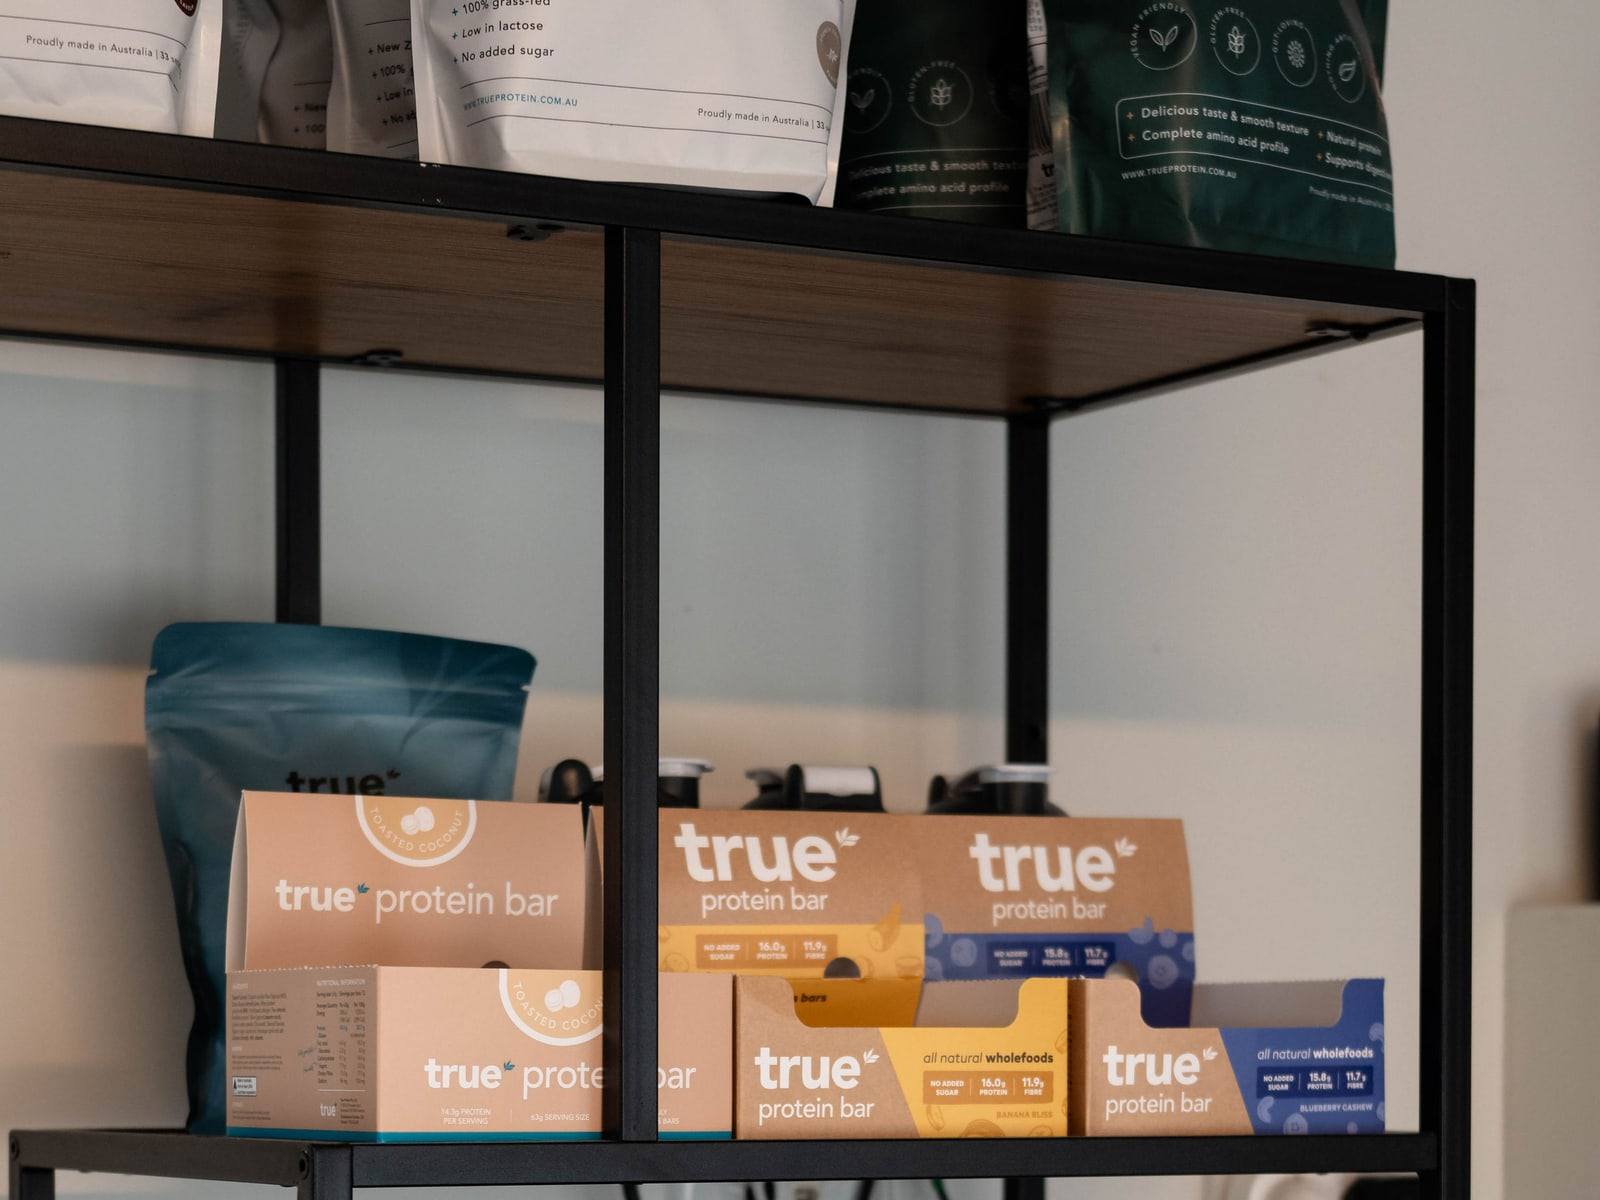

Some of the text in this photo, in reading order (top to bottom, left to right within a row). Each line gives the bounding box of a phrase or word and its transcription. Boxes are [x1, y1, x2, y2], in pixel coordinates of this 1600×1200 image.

[463, 0, 489, 15] 100%
[462, 21, 544, 39] Low in lactose
[26, 35, 64, 50] Proudly
[68, 41, 95, 51] made
[98, 41, 107, 52] in
[111, 43, 153, 57] Australia
[462, 45, 555, 63] No added sugar
[698, 108, 825, 130] Proudly made in Australia 33
[1141, 106, 1311, 137] Delicious taste & smooth texture
[1142, 127, 1291, 156] Complete amino acid profile
[370, 807, 465, 854] TOASTED COCONUT
[674, 822, 838, 882] true
[969, 832, 1116, 892] true
[275, 879, 559, 924] true protein bar
[702, 886, 829, 919] protein bar
[993, 895, 1107, 927] protein bar
[513, 980, 604, 1031] TOASTED COCON
[801, 993, 827, 1003] bars
[922, 1052, 1054, 1064] all natural wholefoods
[1257, 1047, 1374, 1061] all natural wholefoods
[755, 1046, 861, 1090] true
[1102, 1045, 1200, 1086] true
[424, 1058, 604, 1101] true prote
[930, 1080, 965, 1088] NO ADDED
[982, 1078, 1006, 1089] 16.0g
[1022, 1077, 1045, 1089] 11.9g
[1268, 1083, 1289, 1091] SUGAR
[1309, 1072, 1331, 1082] 15.8g
[1346, 1072, 1366, 1082] 11.7g
[320, 1104, 337, 1118] true
[759, 1095, 875, 1126] protein bar
[1105, 1091, 1212, 1120] protein bar
[1300, 1103, 1374, 1112] BLUEBERRY CASHEW
